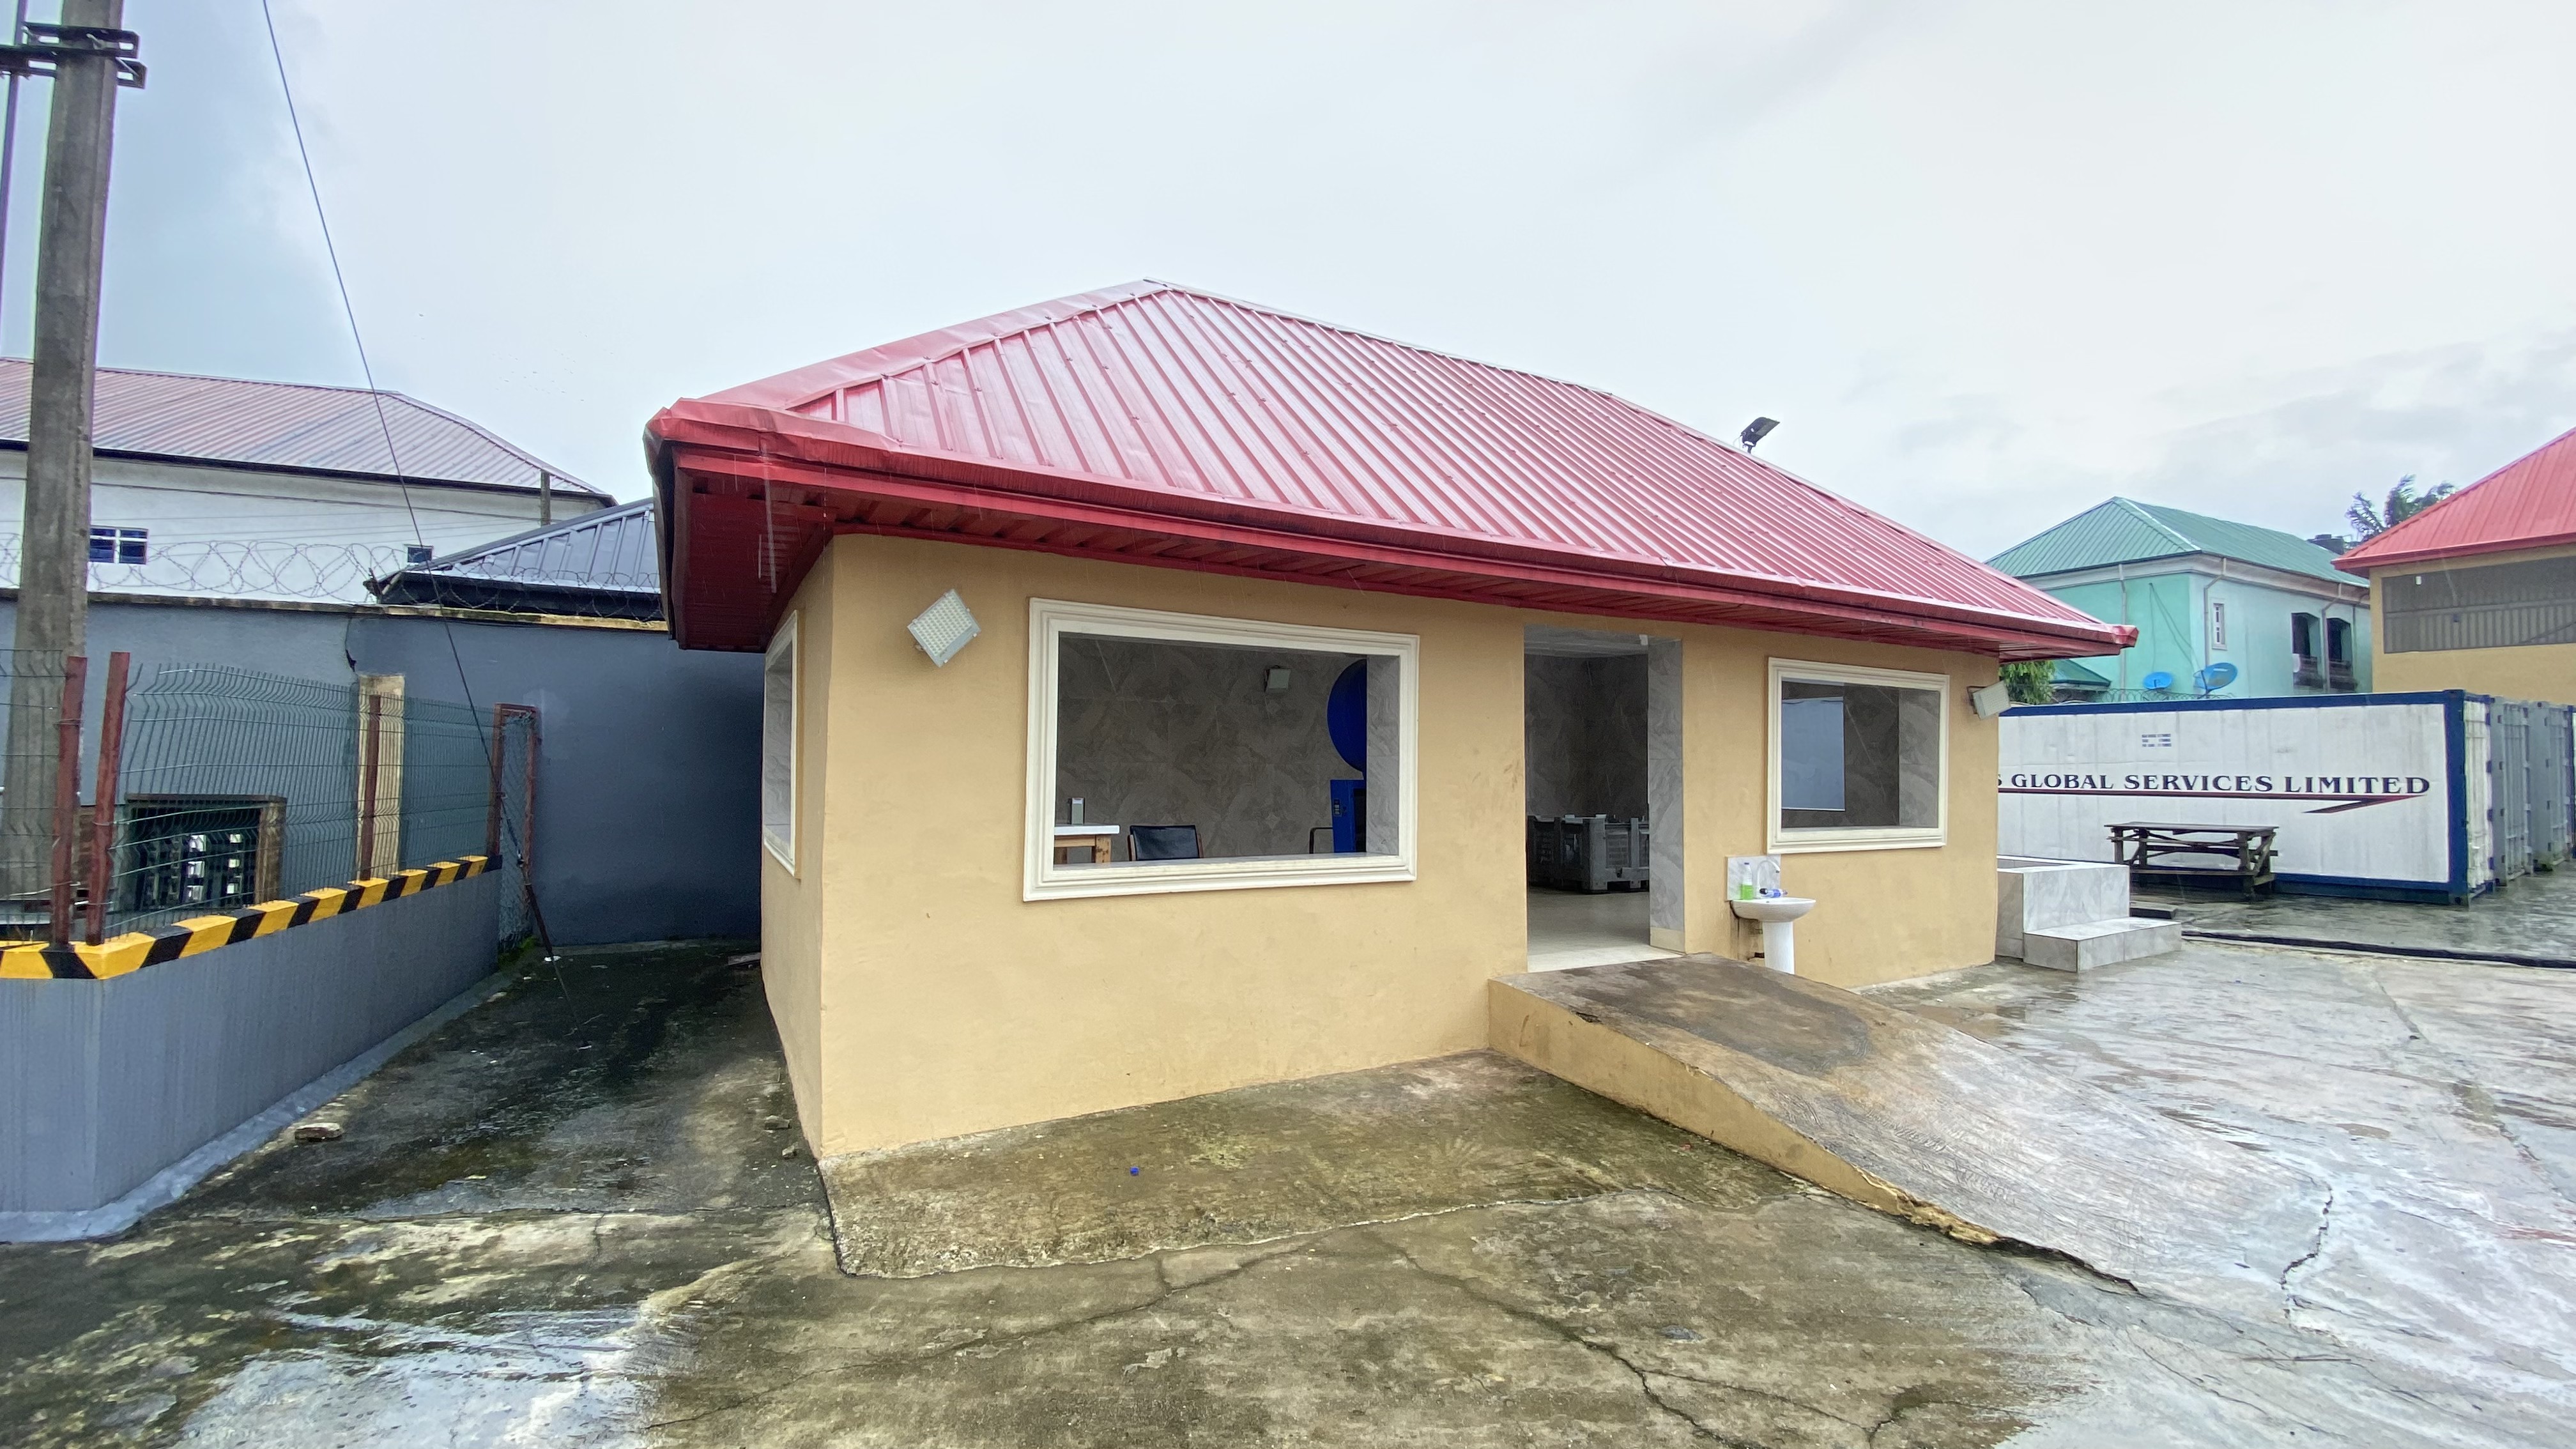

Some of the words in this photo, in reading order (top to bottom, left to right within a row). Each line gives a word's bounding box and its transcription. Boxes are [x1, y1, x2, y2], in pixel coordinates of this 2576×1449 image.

[2011, 774, 2113, 789] GLOBAL
[2124, 775, 2273, 792] SERVICES
[2285, 776, 2430, 793] LIMITED
